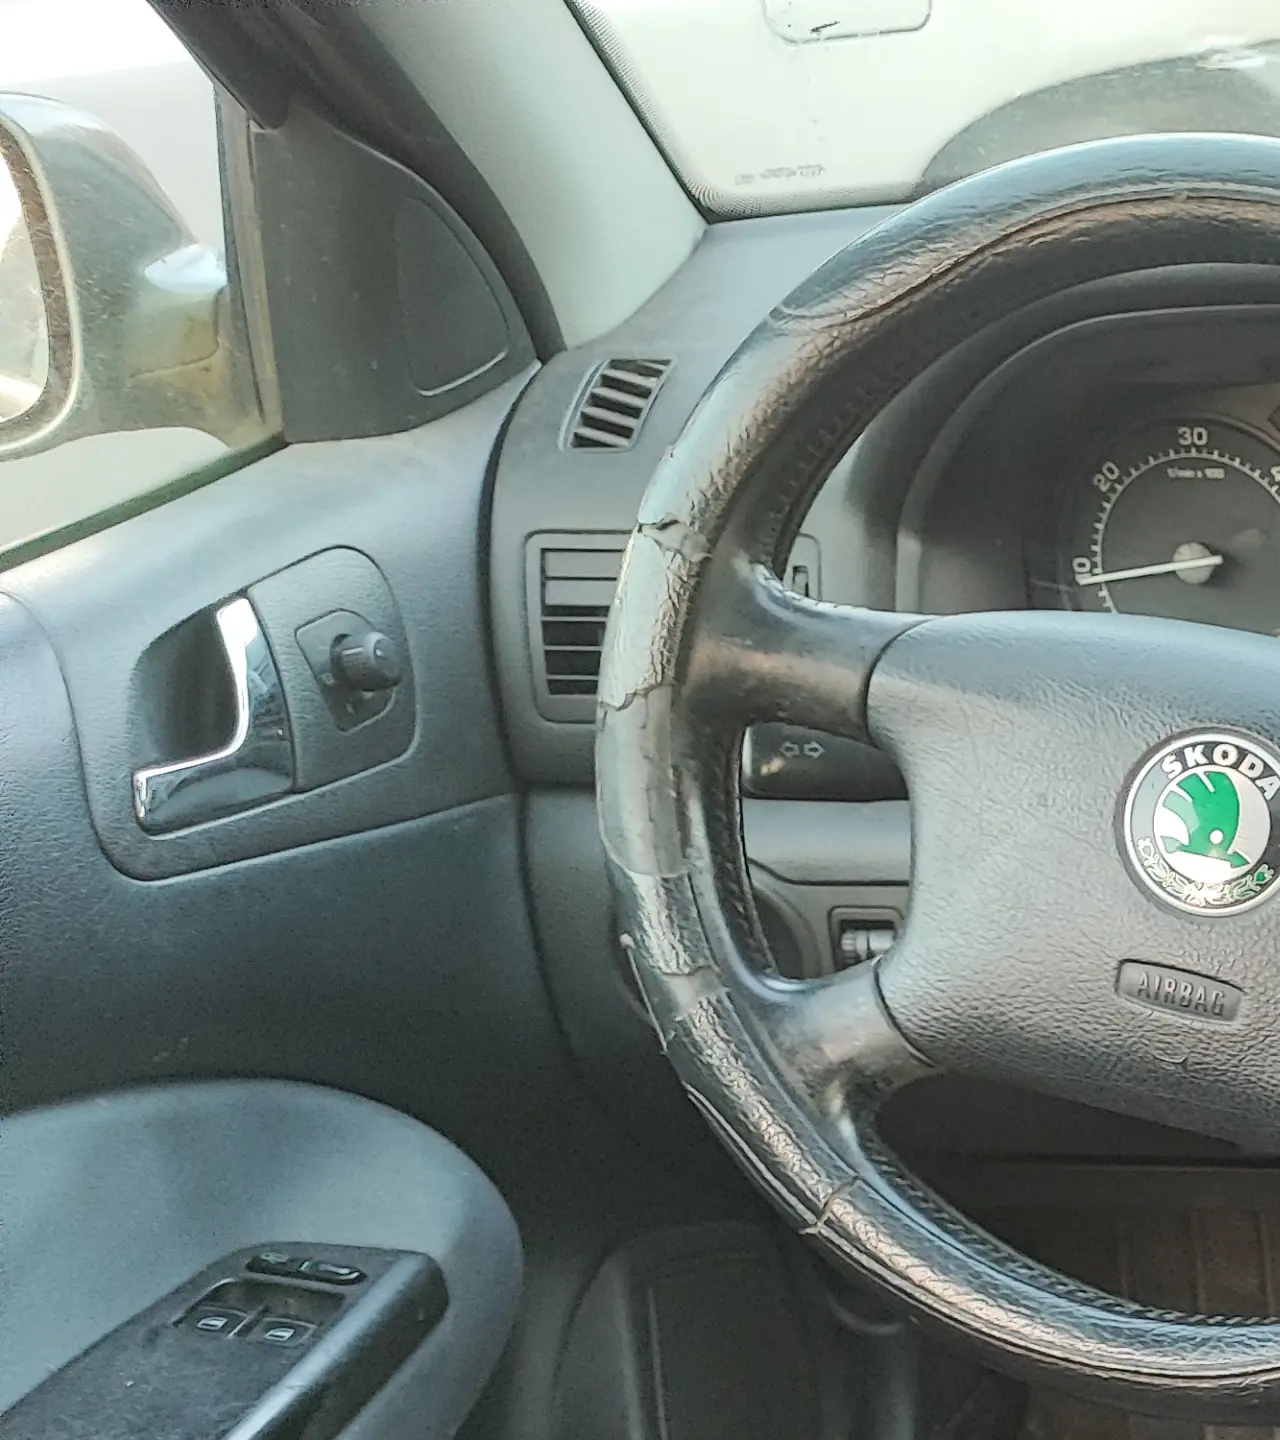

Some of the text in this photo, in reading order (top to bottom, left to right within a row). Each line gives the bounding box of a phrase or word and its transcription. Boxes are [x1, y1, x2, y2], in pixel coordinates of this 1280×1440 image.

[1177, 427, 1208, 446] 30
[1093, 461, 1121, 494] 20
[1137, 970, 1226, 1017] AIRBAG
